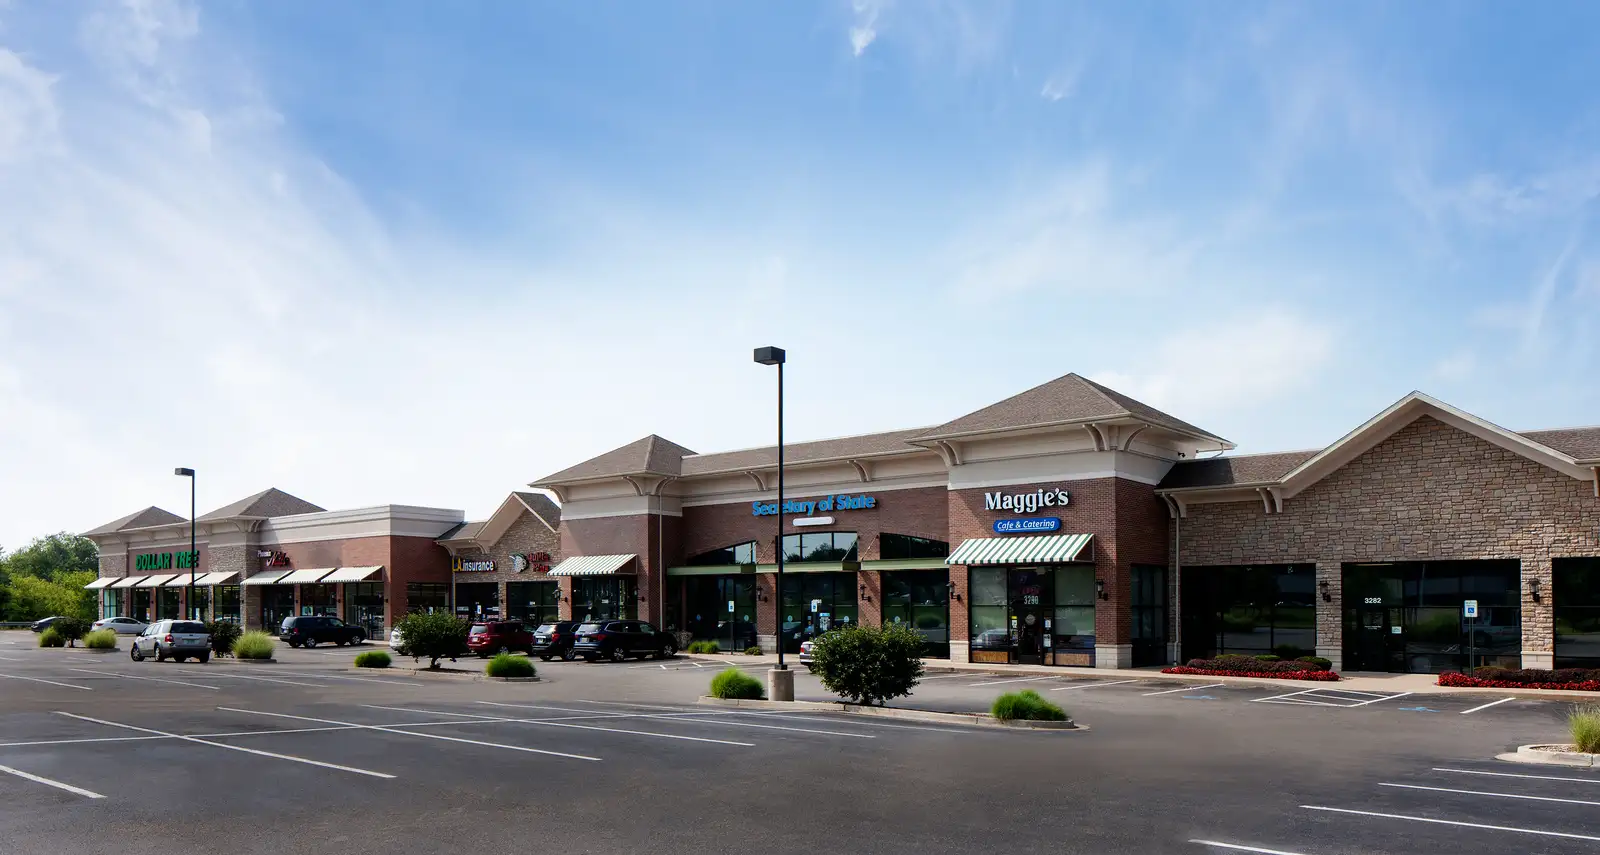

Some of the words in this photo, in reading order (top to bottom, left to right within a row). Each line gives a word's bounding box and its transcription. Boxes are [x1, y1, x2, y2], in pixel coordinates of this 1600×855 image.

[818, 495, 835, 511] of
[837, 494, 876, 510] State
[984, 488, 1069, 513] Maggie's
[997, 521, 1014, 531] Cafe
[1023, 518, 1055, 528] Catering
[136, 551, 171, 570] DOLLAR
[463, 559, 494, 572] insurance
